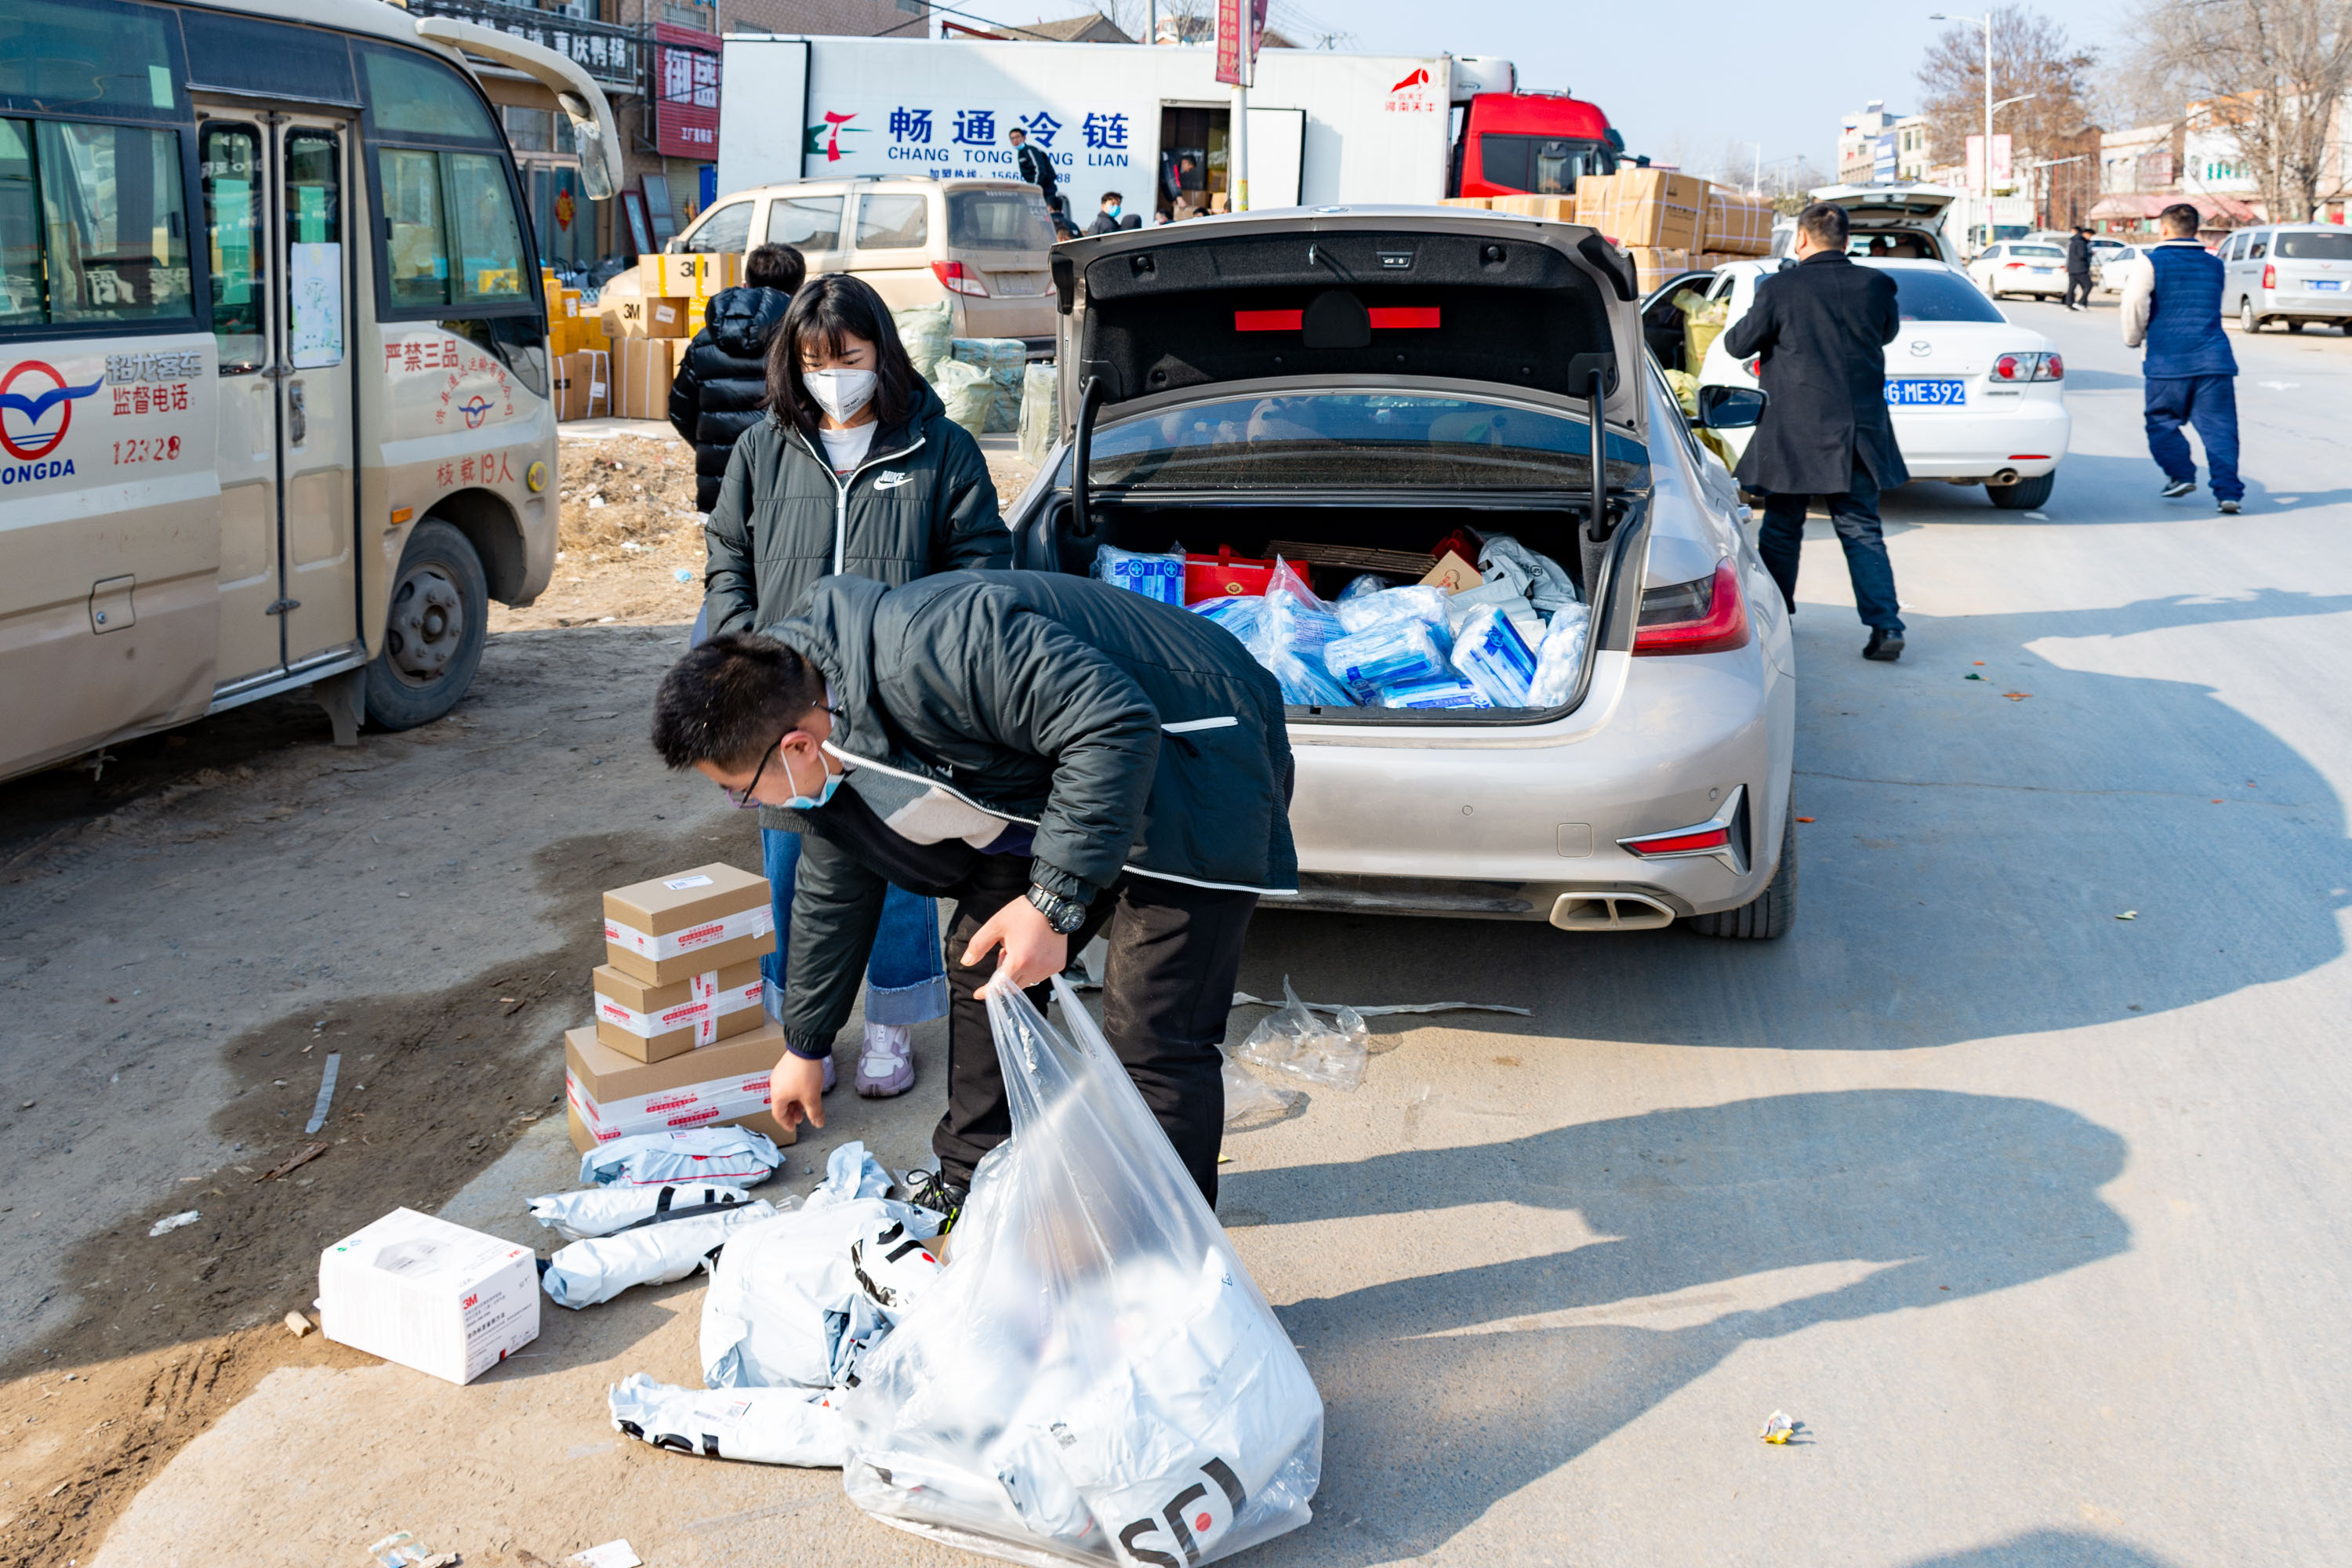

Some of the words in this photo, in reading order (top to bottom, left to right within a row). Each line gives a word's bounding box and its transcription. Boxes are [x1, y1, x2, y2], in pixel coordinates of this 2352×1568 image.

[889, 107, 1129, 149] 畅通冷链
[888, 147, 949, 162] CHANG
[964, 150, 1013, 164] TONG
[1088, 153, 1129, 167] LIAN
[623, 303, 640, 320] 3M
[105, 350, 203, 386] 超龙客车
[385, 339, 459, 373] 严禁三品
[113, 435, 181, 466] 12328
[0, 459, 75, 485] ONGDA
[879, 470, 906, 484] NIKE
[463, 1293, 478, 1310] 3M
